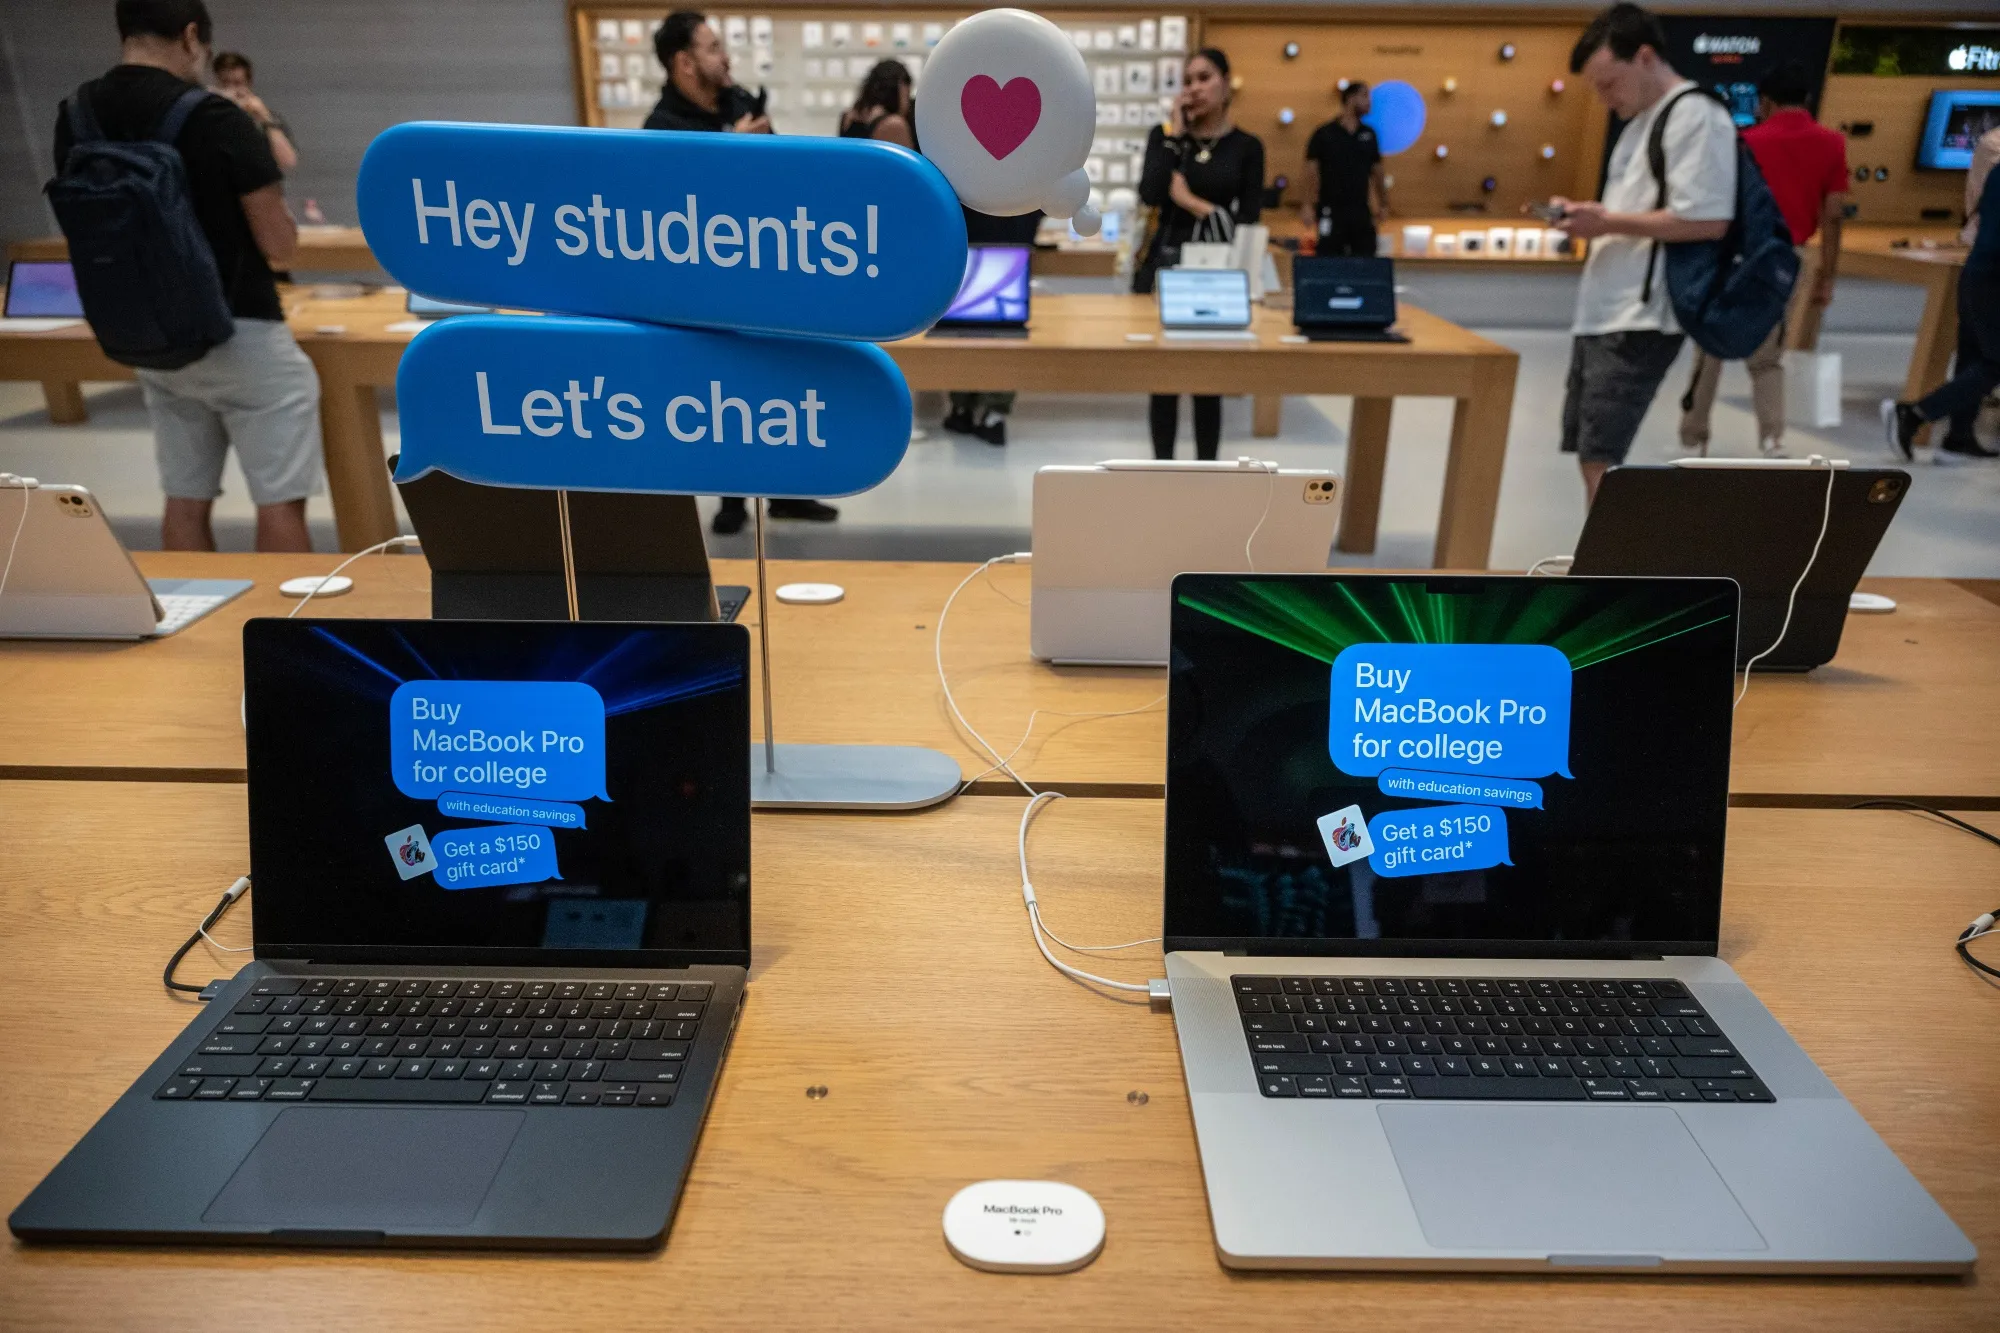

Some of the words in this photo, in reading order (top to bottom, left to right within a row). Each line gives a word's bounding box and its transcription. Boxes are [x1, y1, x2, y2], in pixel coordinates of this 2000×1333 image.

[412, 178, 535, 266] Hey
[555, 194, 879, 278] students!
[665, 380, 827, 448] chat
[1355, 663, 1411, 694] Buy
[412, 697, 461, 725] Buy
[1354, 698, 1490, 724] MacBook
[1499, 699, 1547, 725] Pro
[413, 729, 535, 753] MacBook
[542, 730, 585, 754] Pro
[1353, 732, 1391, 758] for
[1398, 733, 1503, 765] college
[413, 760, 447, 783] for
[454, 761, 547, 788] college
[1388, 777, 1415, 791] with
[1417, 779, 1481, 797] education
[1483, 786, 1532, 802] savings
[446, 799, 470, 812] with
[473, 802, 530, 817] education
[532, 807, 576, 823] savings
[1382, 823, 1417, 842] Get
[1423, 825, 1435, 838] a
[1439, 815, 1491, 837] $150
[443, 841, 475, 857] Get
[480, 843, 490, 855] a
[494, 834, 541, 854] $150
[1384, 847, 1416, 868] gift
[446, 862, 475, 882] gift
[983, 1204, 1040, 1215] MacBook
[1043, 1205, 1063, 1216] Pro
